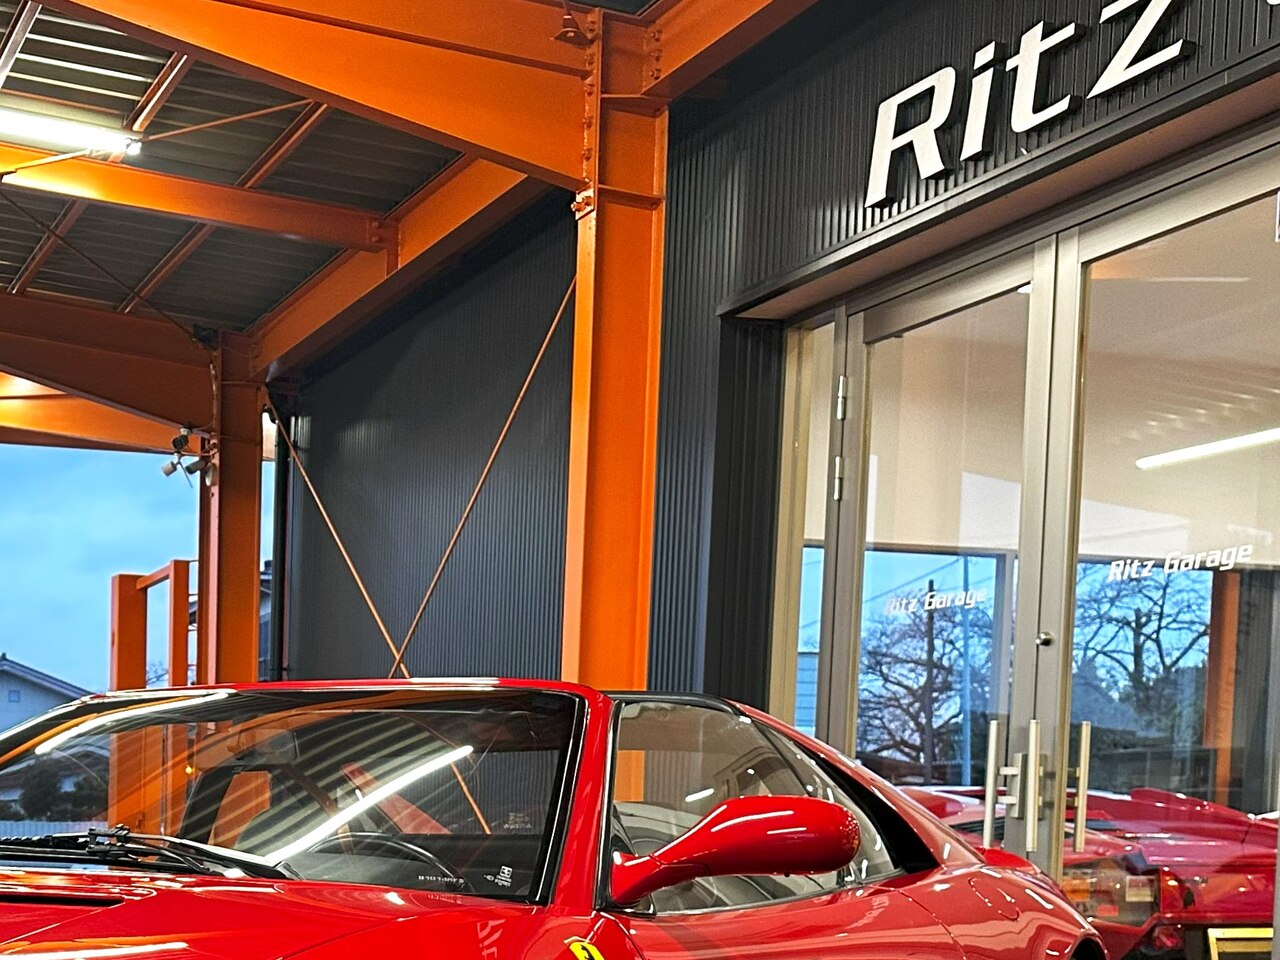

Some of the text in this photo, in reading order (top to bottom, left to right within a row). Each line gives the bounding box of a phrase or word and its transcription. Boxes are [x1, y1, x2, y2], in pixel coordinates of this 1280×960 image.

[865, 0, 1184, 208] Ritz
[1107, 544, 1254, 583] Ritz Garage
